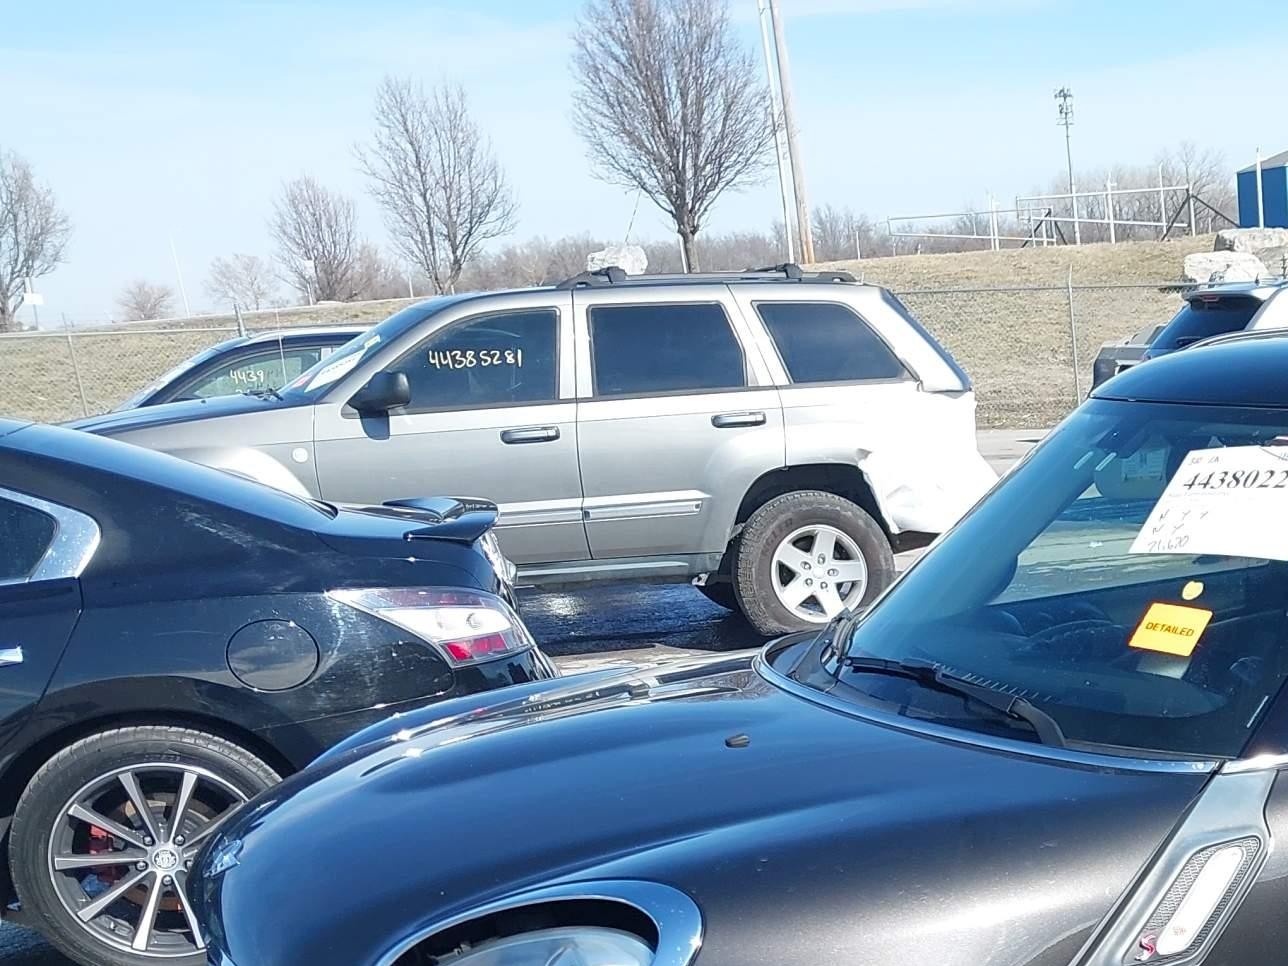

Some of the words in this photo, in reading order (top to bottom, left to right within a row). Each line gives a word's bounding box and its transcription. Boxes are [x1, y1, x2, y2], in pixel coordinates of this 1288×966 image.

[429, 349, 523, 370] 44385281
[229, 369, 265, 385] 4439
[1145, 620, 1195, 638] DETAILED
